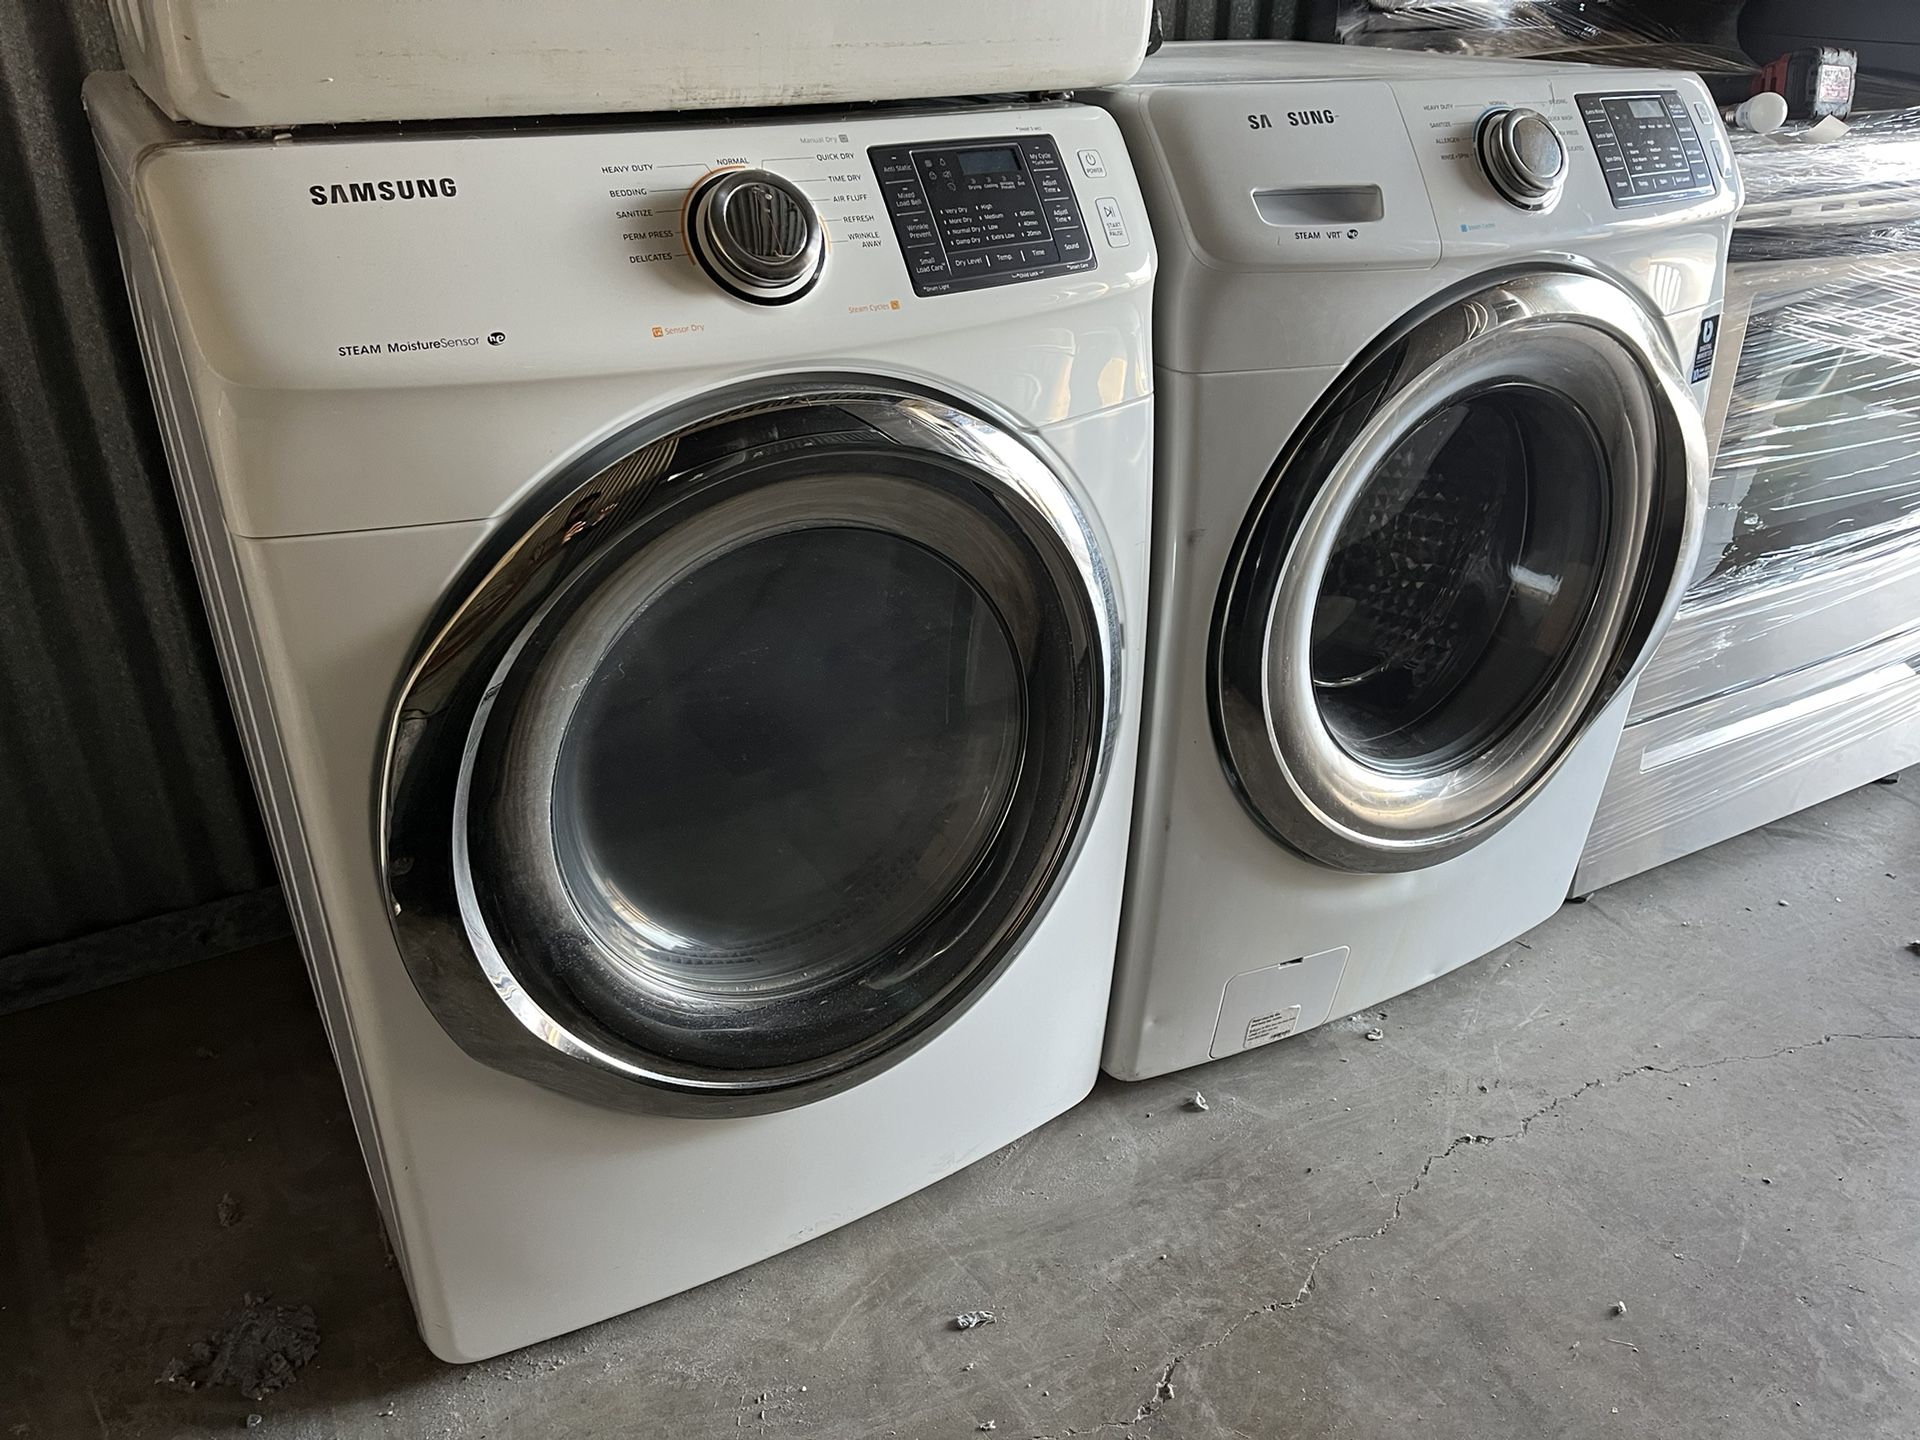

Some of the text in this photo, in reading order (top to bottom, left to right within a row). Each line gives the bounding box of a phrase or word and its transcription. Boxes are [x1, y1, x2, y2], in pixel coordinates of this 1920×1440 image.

[716, 157, 749, 165] NORMAL
[601, 164, 653, 174] HEAVY DUTY
[309, 177, 457, 206] SAMSUNG
[609, 188, 648, 198] BEDDING
[897, 191, 915, 199] Mixed
[846, 194, 867, 202] FLUFF
[896, 200, 910, 208] Load
[616, 209, 653, 219] SANITIZE
[1054, 209, 1068, 217] Adjust
[843, 215, 874, 223] REFRESH
[971, 226, 981, 234] Dry
[623, 230, 674, 241] PERM PRESS
[848, 232, 880, 240] WRINKLE
[909, 231, 932, 239] Prevent
[1295, 232, 1321, 240] STEAM
[862, 240, 881, 248] AWAY
[629, 252, 673, 264] DELICATES
[955, 259, 966, 267] Dry
[848, 303, 889, 314] Steam Cycles
[664, 323, 704, 336] Sensor Dry
[338, 335, 480, 357] STEAM MoistureSensor
